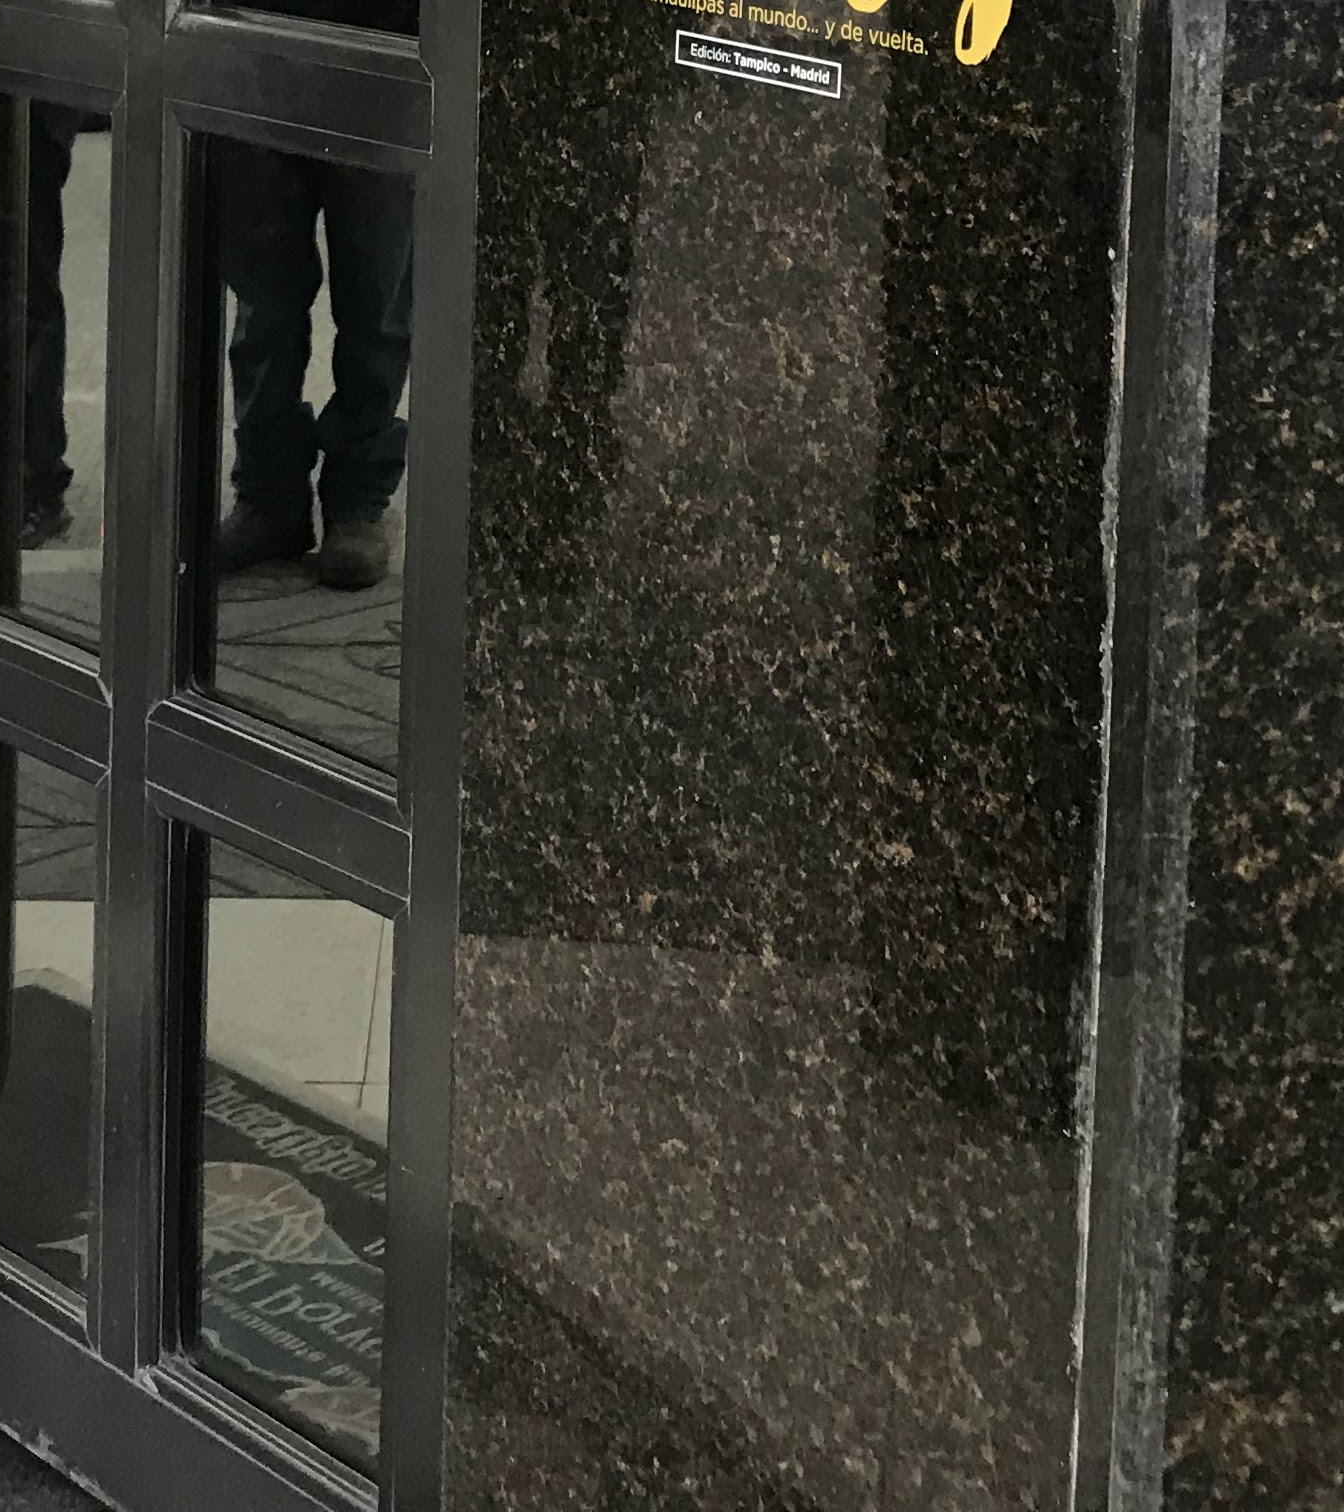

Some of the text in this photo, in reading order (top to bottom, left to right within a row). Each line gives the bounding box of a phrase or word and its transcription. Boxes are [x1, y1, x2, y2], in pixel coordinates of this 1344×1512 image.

[748, 5, 819, 35] mundo...
[825, 21, 836, 41] y
[841, 18, 863, 42] de
[868, 28, 929, 56] vuelta.
[690, 42, 732, 65] Edición:
[733, 51, 781, 75] Tampico
[791, 63, 830, 85] Madrid
